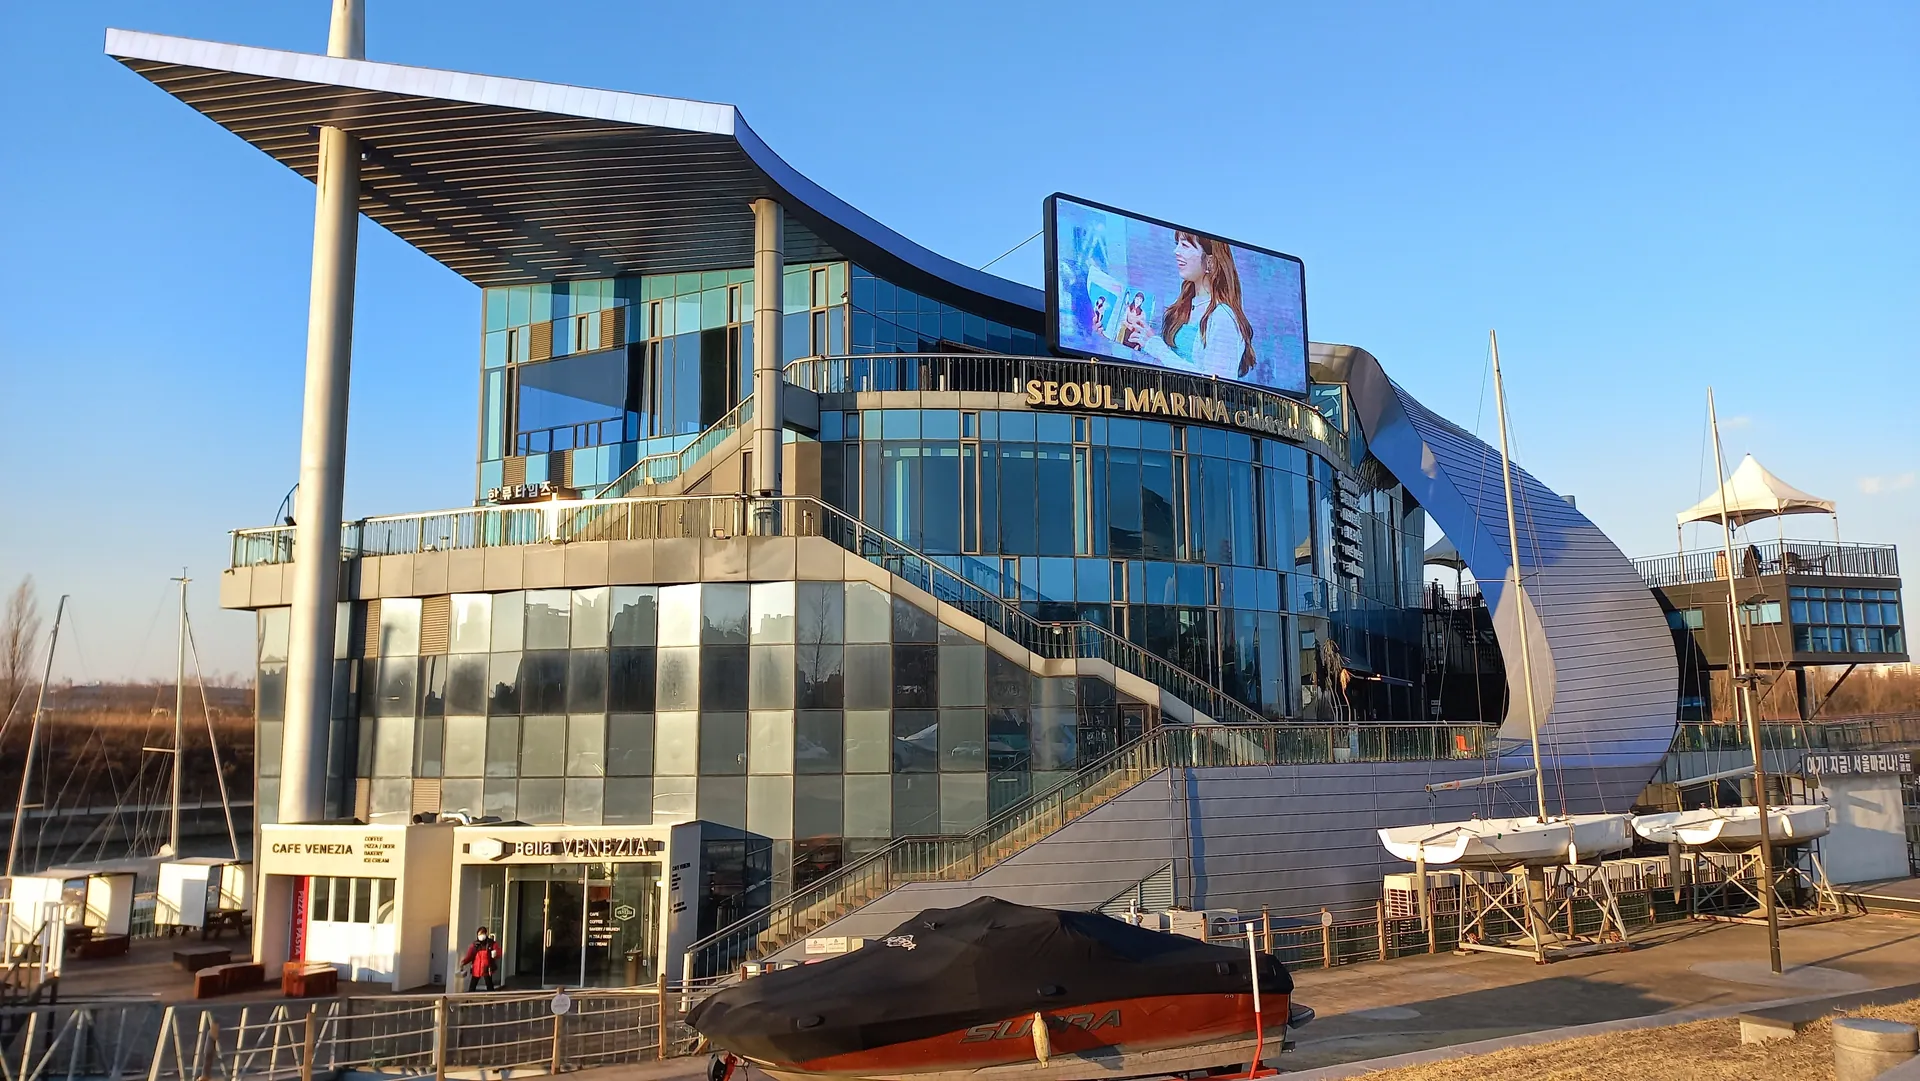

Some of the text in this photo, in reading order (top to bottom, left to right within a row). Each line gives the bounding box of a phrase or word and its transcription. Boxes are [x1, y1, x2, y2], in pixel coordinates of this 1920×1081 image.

[1025, 379, 1119, 411] SEOUL
[1124, 387, 1231, 424] MARINA
[488, 480, 551, 502] 한류타임즈
[1830, 755, 1852, 774] 지금!
[1854, 754, 1899, 773] 서울마리나!
[272, 843, 353, 855] CAFE VENEZIA
[515, 838, 648, 857] Bella VENEZIA
[297, 890, 305, 916] PIZZA
[295, 927, 303, 956] PASTA
[959, 1009, 1123, 1044] SURA
